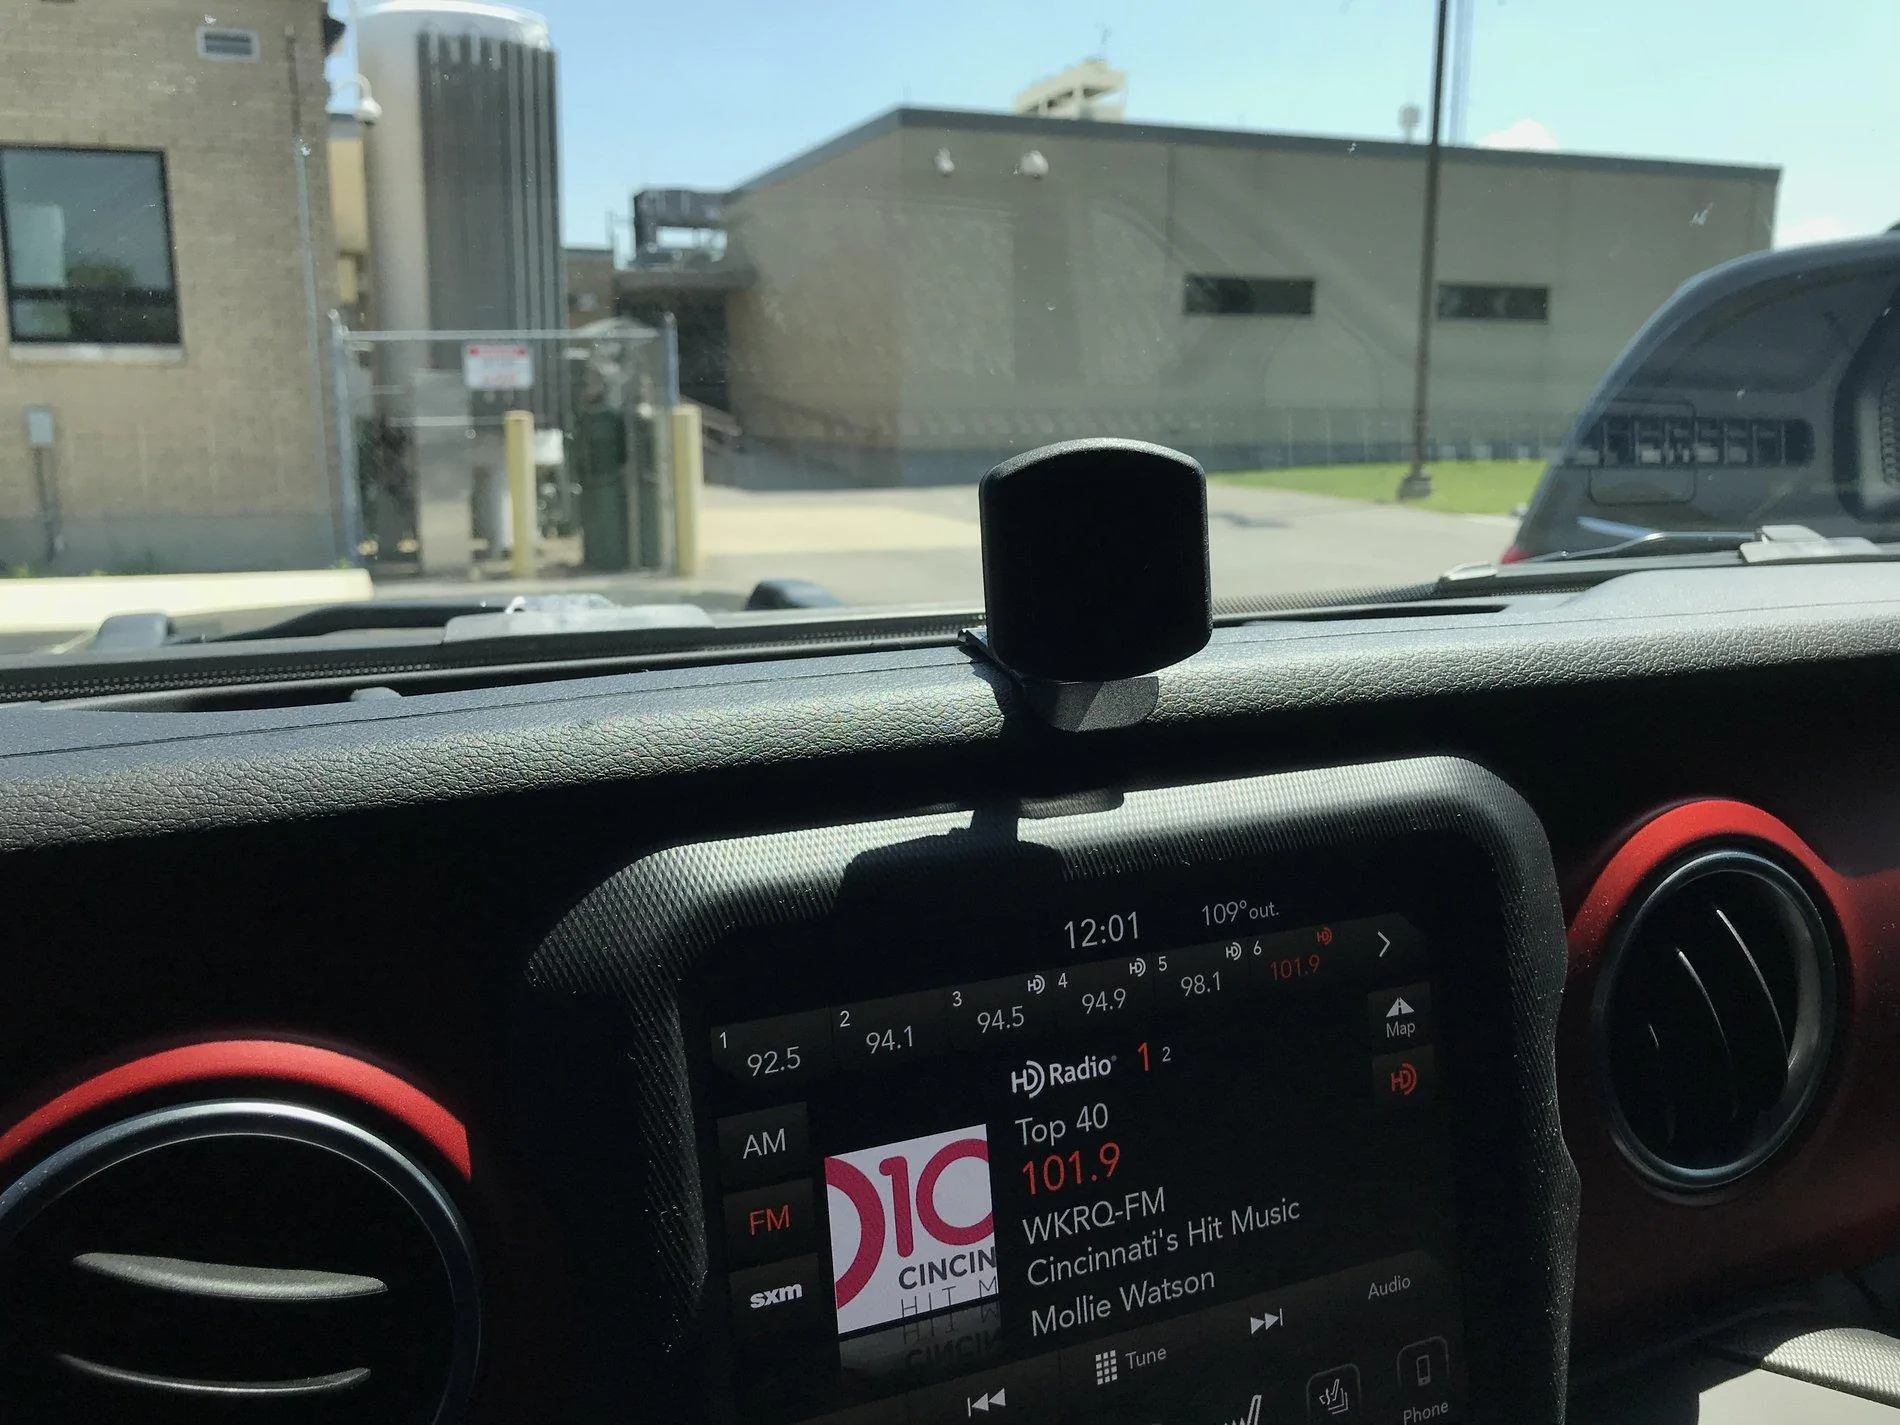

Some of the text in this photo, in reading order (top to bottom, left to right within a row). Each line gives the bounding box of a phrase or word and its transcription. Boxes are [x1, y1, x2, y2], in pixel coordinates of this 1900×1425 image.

[1064, 911, 1138, 949] 12:01
[1253, 940, 1262, 956] 6
[1158, 955, 1168, 972] 5
[1270, 954, 1320, 981] 101.9
[1058, 972, 1068, 988] 4
[1180, 971, 1221, 997] 98.1
[952, 990, 963, 1007] 3
[1081, 988, 1126, 1015] 94.9
[839, 1010, 851, 1028] 2
[977, 1005, 1025, 1034] 94.5
[1386, 1020, 1416, 1038] Map
[719, 1031, 727, 1049] 1
[865, 1025, 913, 1054] 94.1
[747, 1045, 801, 1077] 92.5
[1137, 1042, 1150, 1072] 1
[1162, 1046, 1171, 1063] 2
[1015, 1102, 1109, 1147] Top 40
[742, 1127, 786, 1160] AM
[1022, 1142, 1121, 1196] 101.9
[749, 1204, 790, 1236] FM
[1021, 1186, 1166, 1246] WKRQ-FM
[1027, 1197, 1300, 1288] Cincinnati's Hit Music
[899, 1246, 996, 1290] CINCIN
[749, 1283, 803, 1309] sxm
[1367, 1275, 1411, 1300] Audio
[901, 1286, 956, 1319] HIT
[1031, 1271, 1215, 1337] Mollie Watson
[1126, 1347, 1167, 1370] Tune
[1403, 1400, 1449, 1425] Phone
